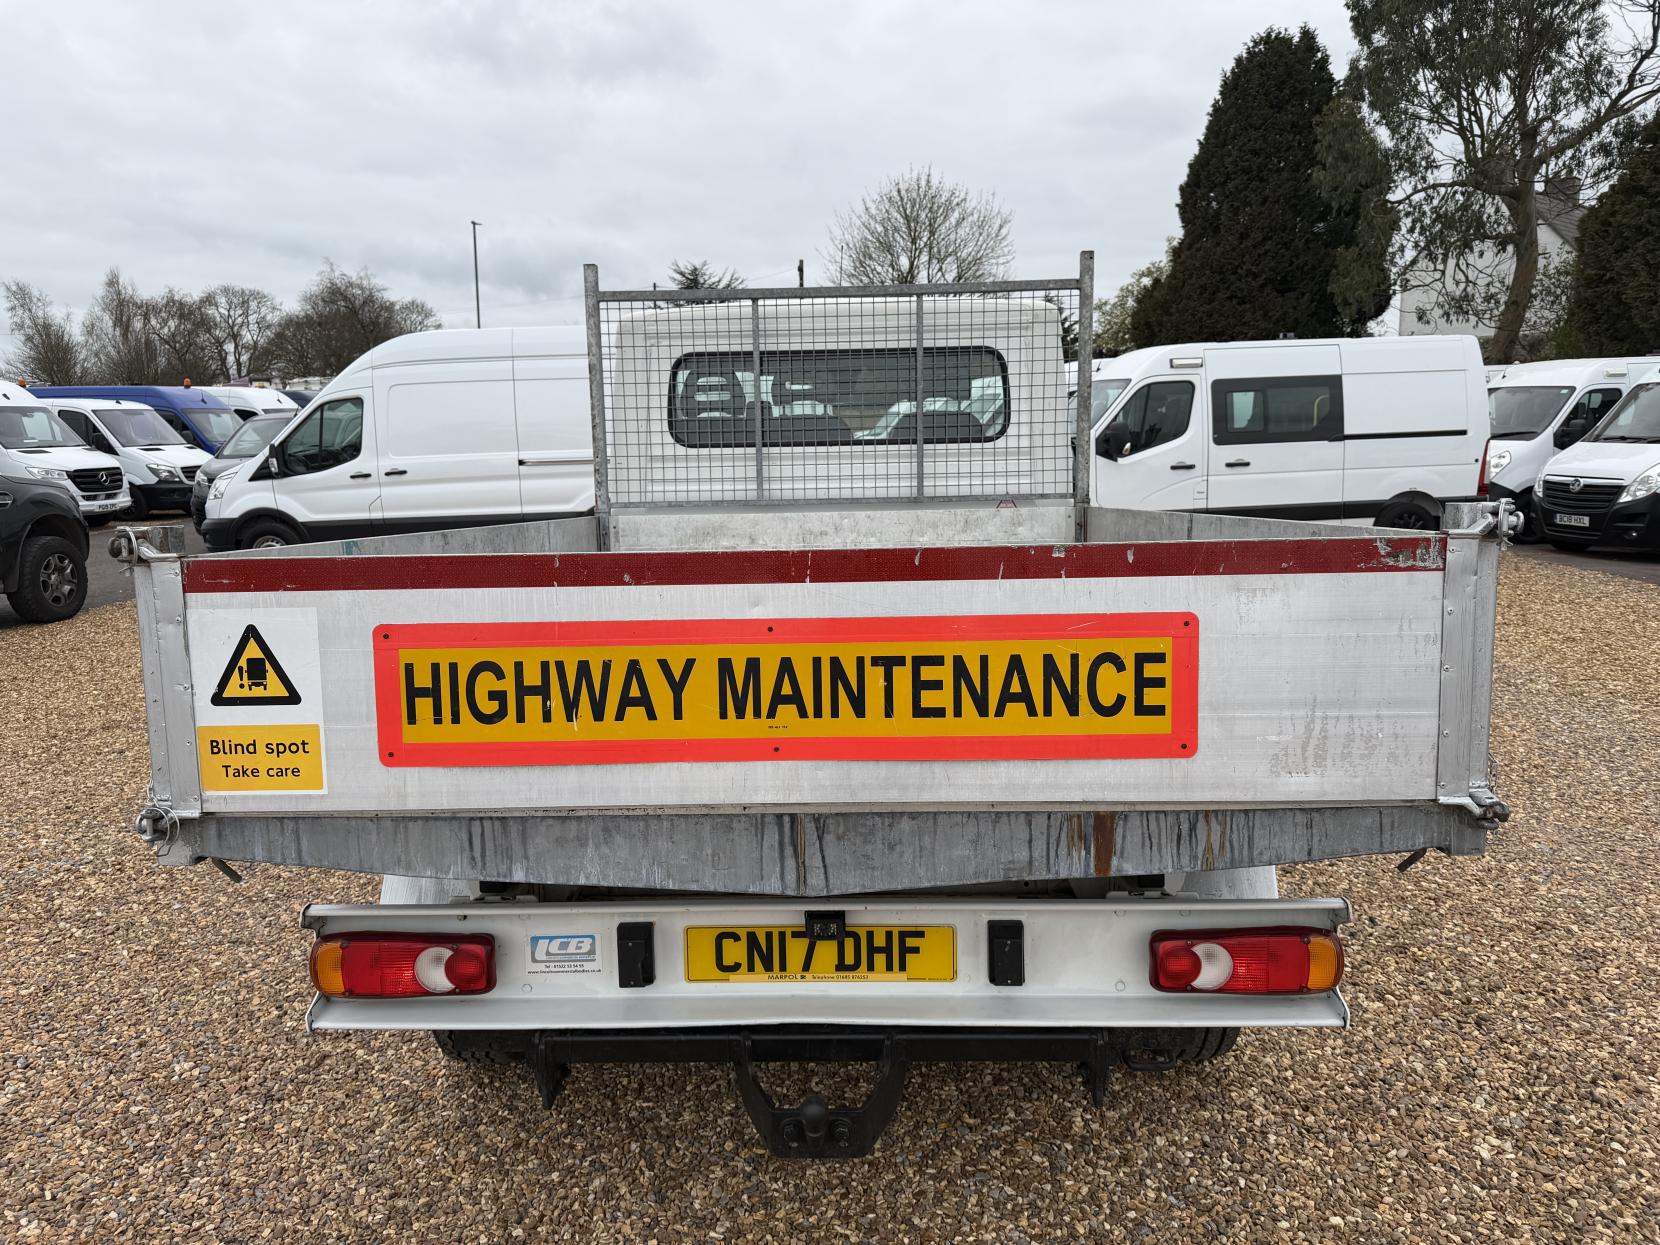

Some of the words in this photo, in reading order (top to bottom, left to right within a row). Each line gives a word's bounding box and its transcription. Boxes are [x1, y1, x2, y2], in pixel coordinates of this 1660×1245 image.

[404, 657, 697, 725] HIGHWAY
[717, 651, 1167, 721] MAINTENANCE
[210, 739, 257, 755] Blind
[265, 739, 310, 758] spot
[222, 765, 260, 778] Take
[266, 767, 301, 778] care
[535, 938, 592, 960] LCB
[714, 930, 818, 973] CN17
[835, 930, 926, 972] DHF
